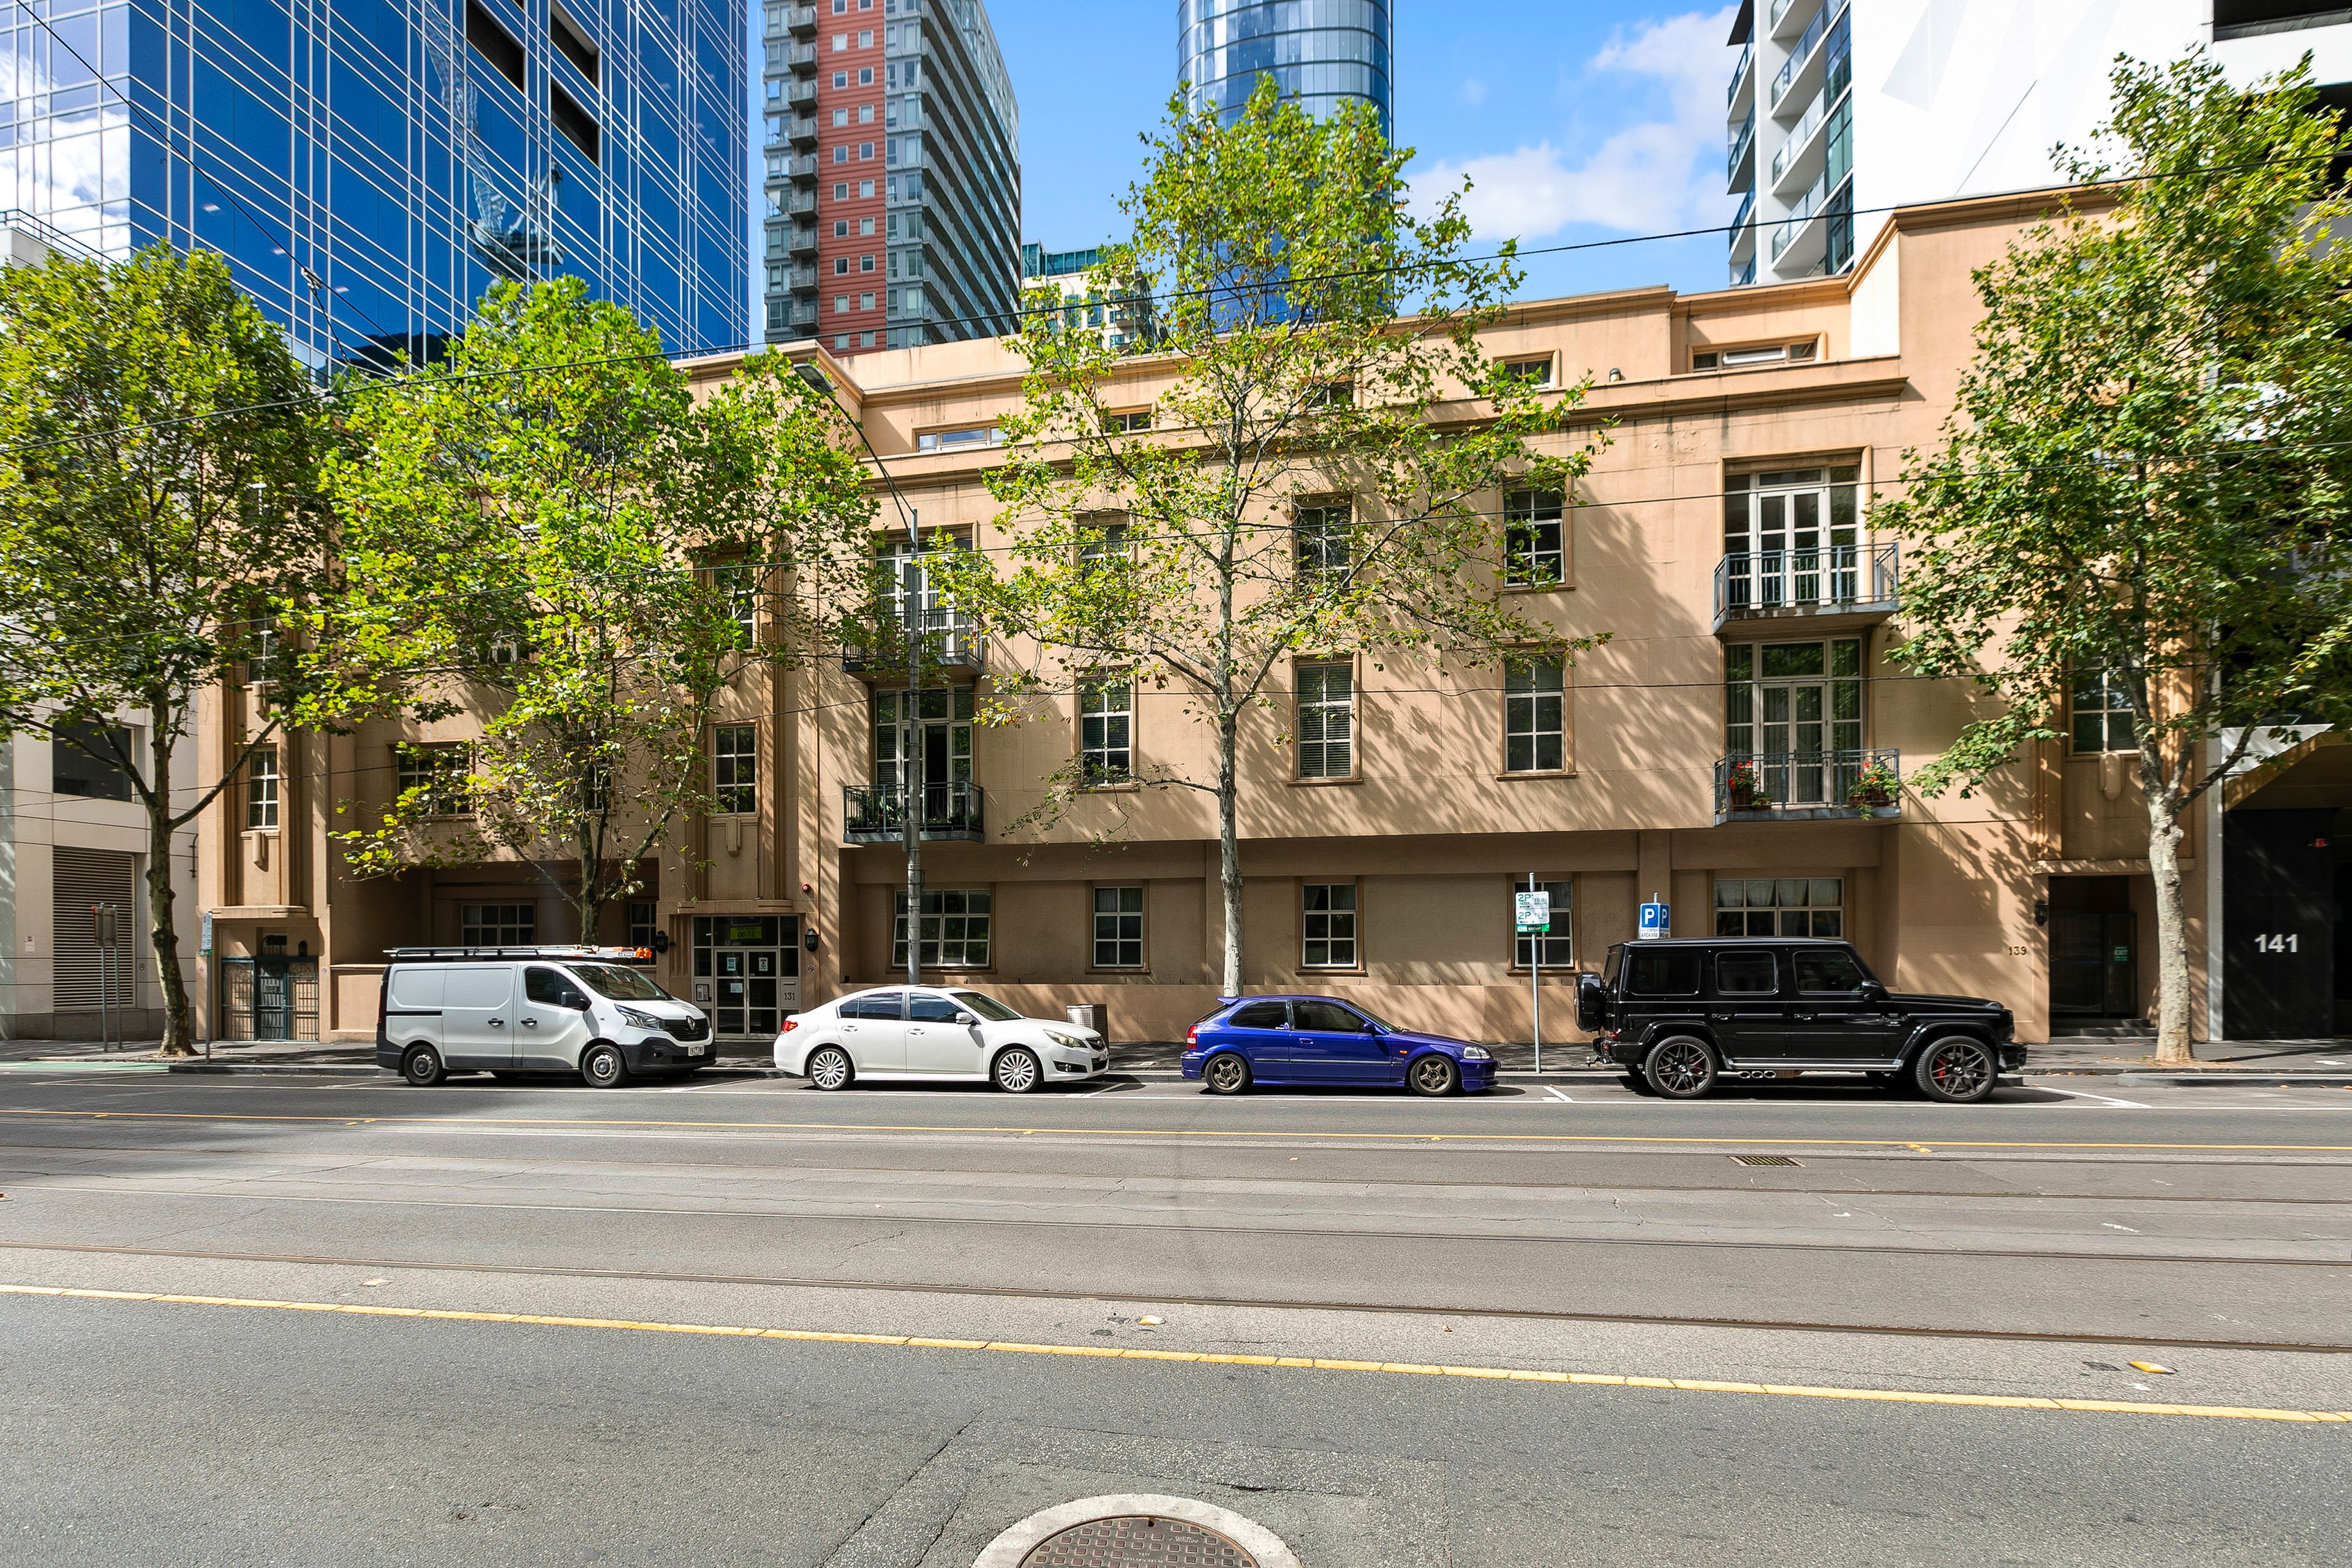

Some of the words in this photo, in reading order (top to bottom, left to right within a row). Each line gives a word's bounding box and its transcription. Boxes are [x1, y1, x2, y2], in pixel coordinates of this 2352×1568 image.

[1645, 908, 1655, 925] P
[1662, 908, 1667, 924] P
[2254, 933, 2297, 952] 141
[2009, 946, 2027, 956] 139
